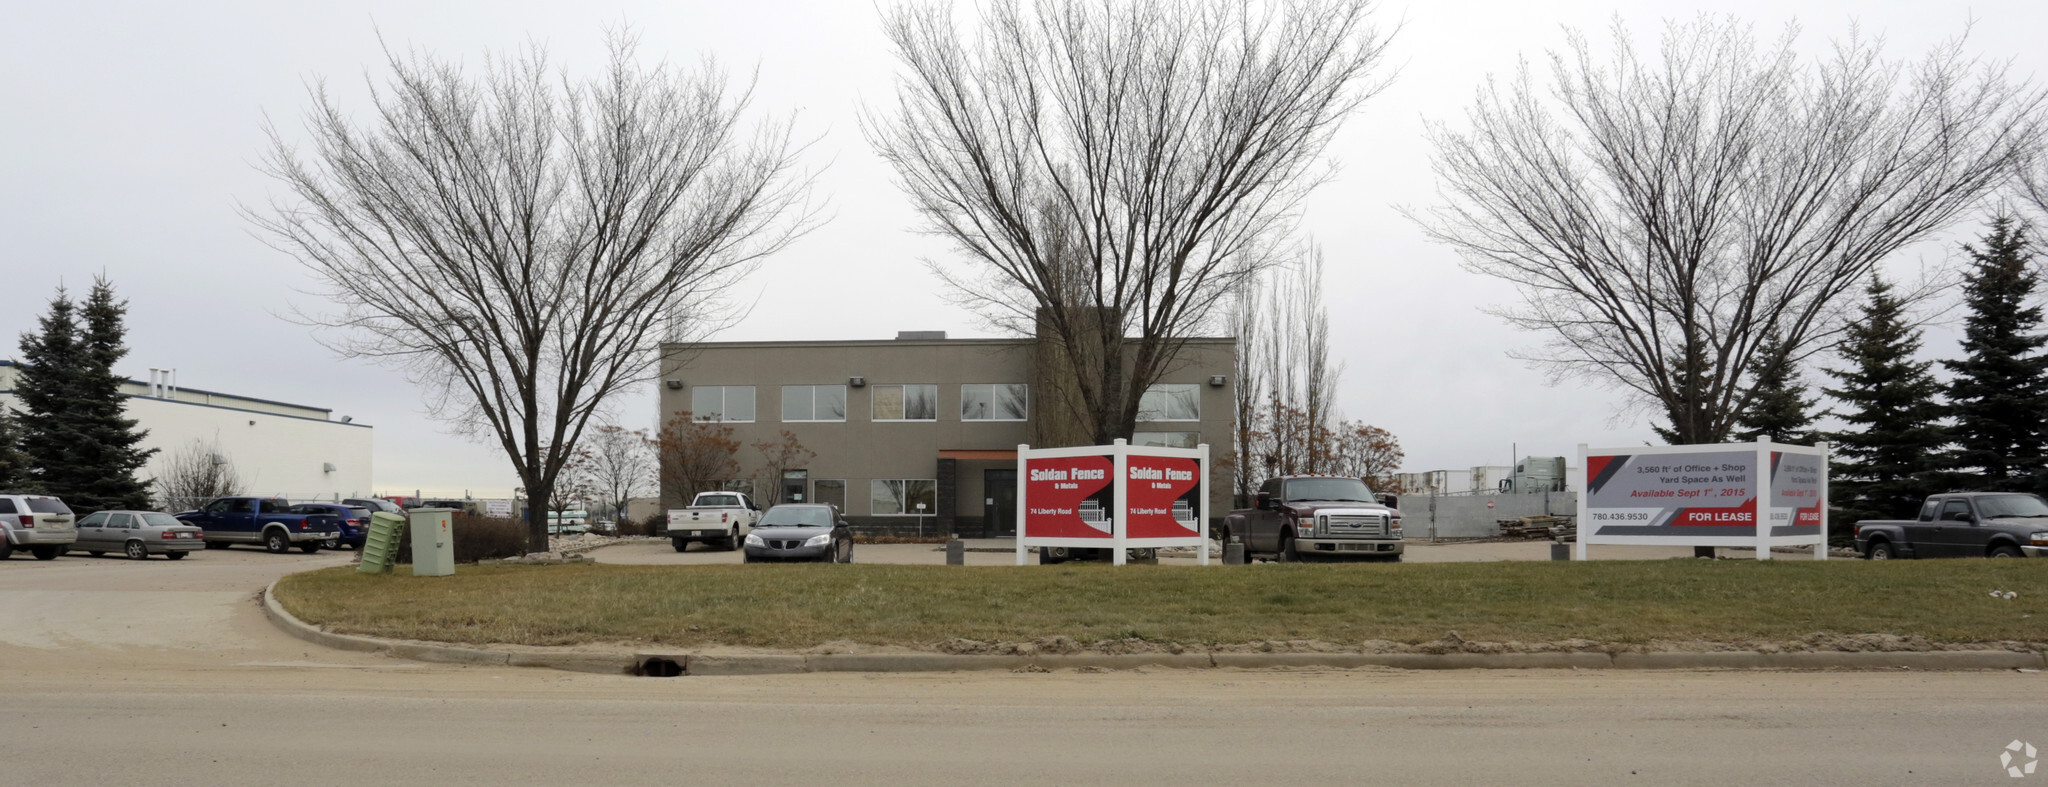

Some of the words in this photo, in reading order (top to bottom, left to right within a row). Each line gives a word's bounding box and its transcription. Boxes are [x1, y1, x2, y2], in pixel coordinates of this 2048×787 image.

[1030, 468, 1068, 481] Soldan
[1071, 467, 1105, 480] Fence
[1130, 467, 1162, 480] Soldan
[1165, 467, 1192, 480] Fence
[1637, 466, 1659, 474] 3,560
[1674, 465, 1682, 473] of
[1685, 464, 1711, 472] Office
[1722, 464, 1746, 472] Shop
[1660, 476, 1679, 484] Yard
[1682, 476, 1709, 484] Space
[1630, 489, 1674, 498] Available
[1677, 489, 1700, 498] Sept
[1720, 488, 1745, 497] 2015
[1689, 513, 1712, 521] FOR
[1715, 513, 1752, 521] LEASE
